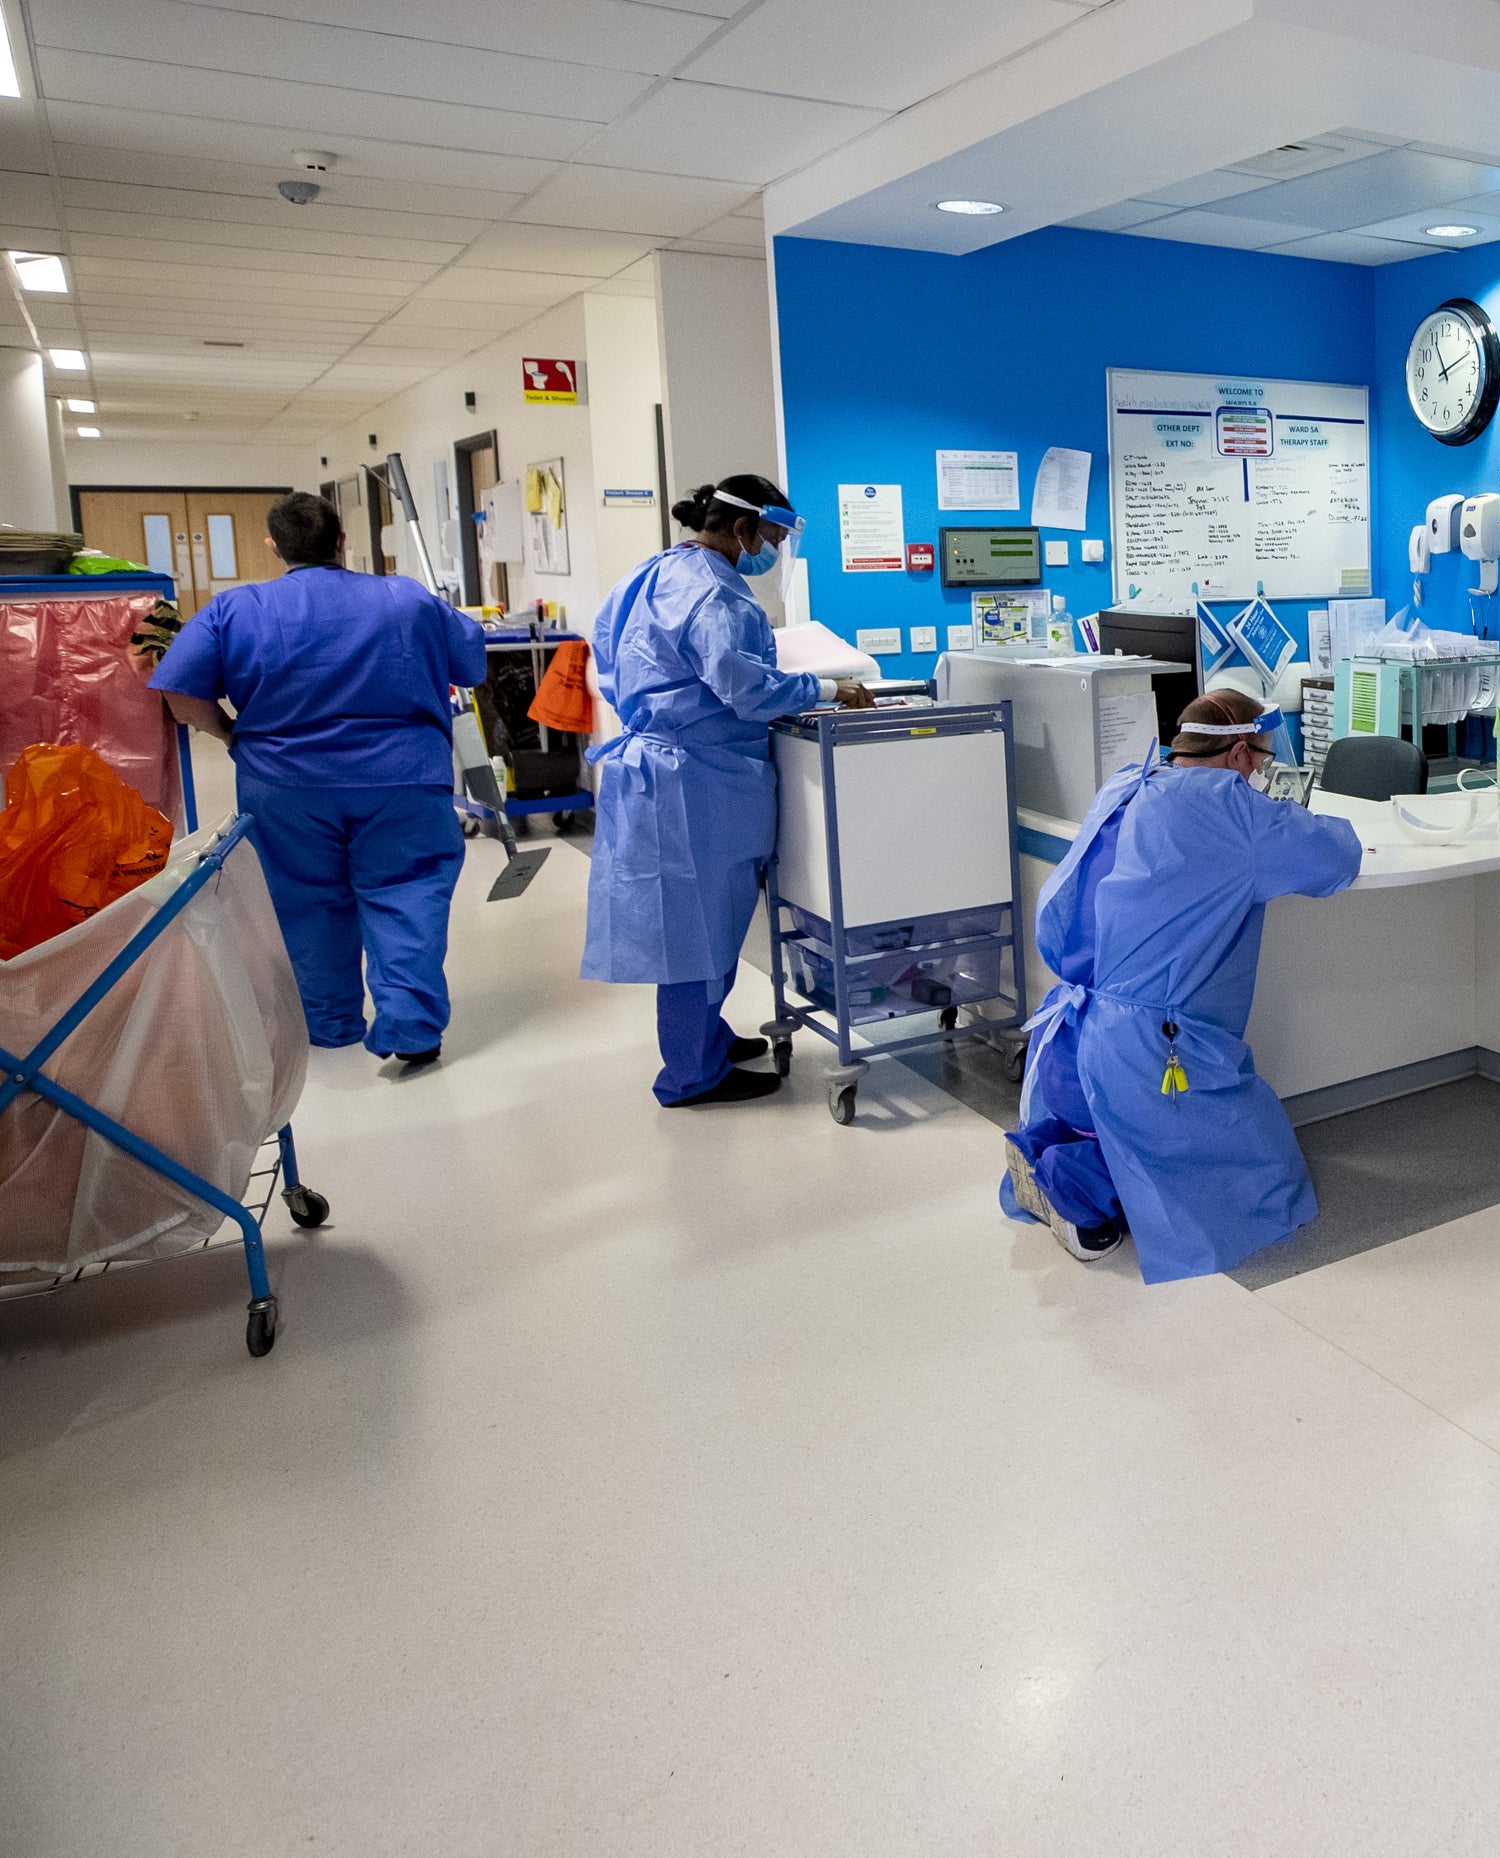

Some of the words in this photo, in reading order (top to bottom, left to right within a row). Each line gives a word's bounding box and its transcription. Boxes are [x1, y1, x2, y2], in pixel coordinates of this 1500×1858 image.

[1441, 323, 1451, 337] 12
[1430, 331, 1438, 346] 11
[1464, 339, 1471, 355] 2
[1422, 349, 1432, 363] 10
[1417, 366, 1425, 381] 9
[1471, 360, 1477, 376] 3
[1218, 387, 1252, 396] WELCOME
[1421, 387, 1429, 402] 8
[1465, 382, 1472, 396] 4
[1432, 402, 1438, 415] 7
[1457, 398, 1464, 413] 5
[1443, 406, 1451, 420] 6
[1157, 424, 1181, 432] OTHER
[1166, 440, 1179, 448] EXT
[1180, 440, 1194, 448] NO:
